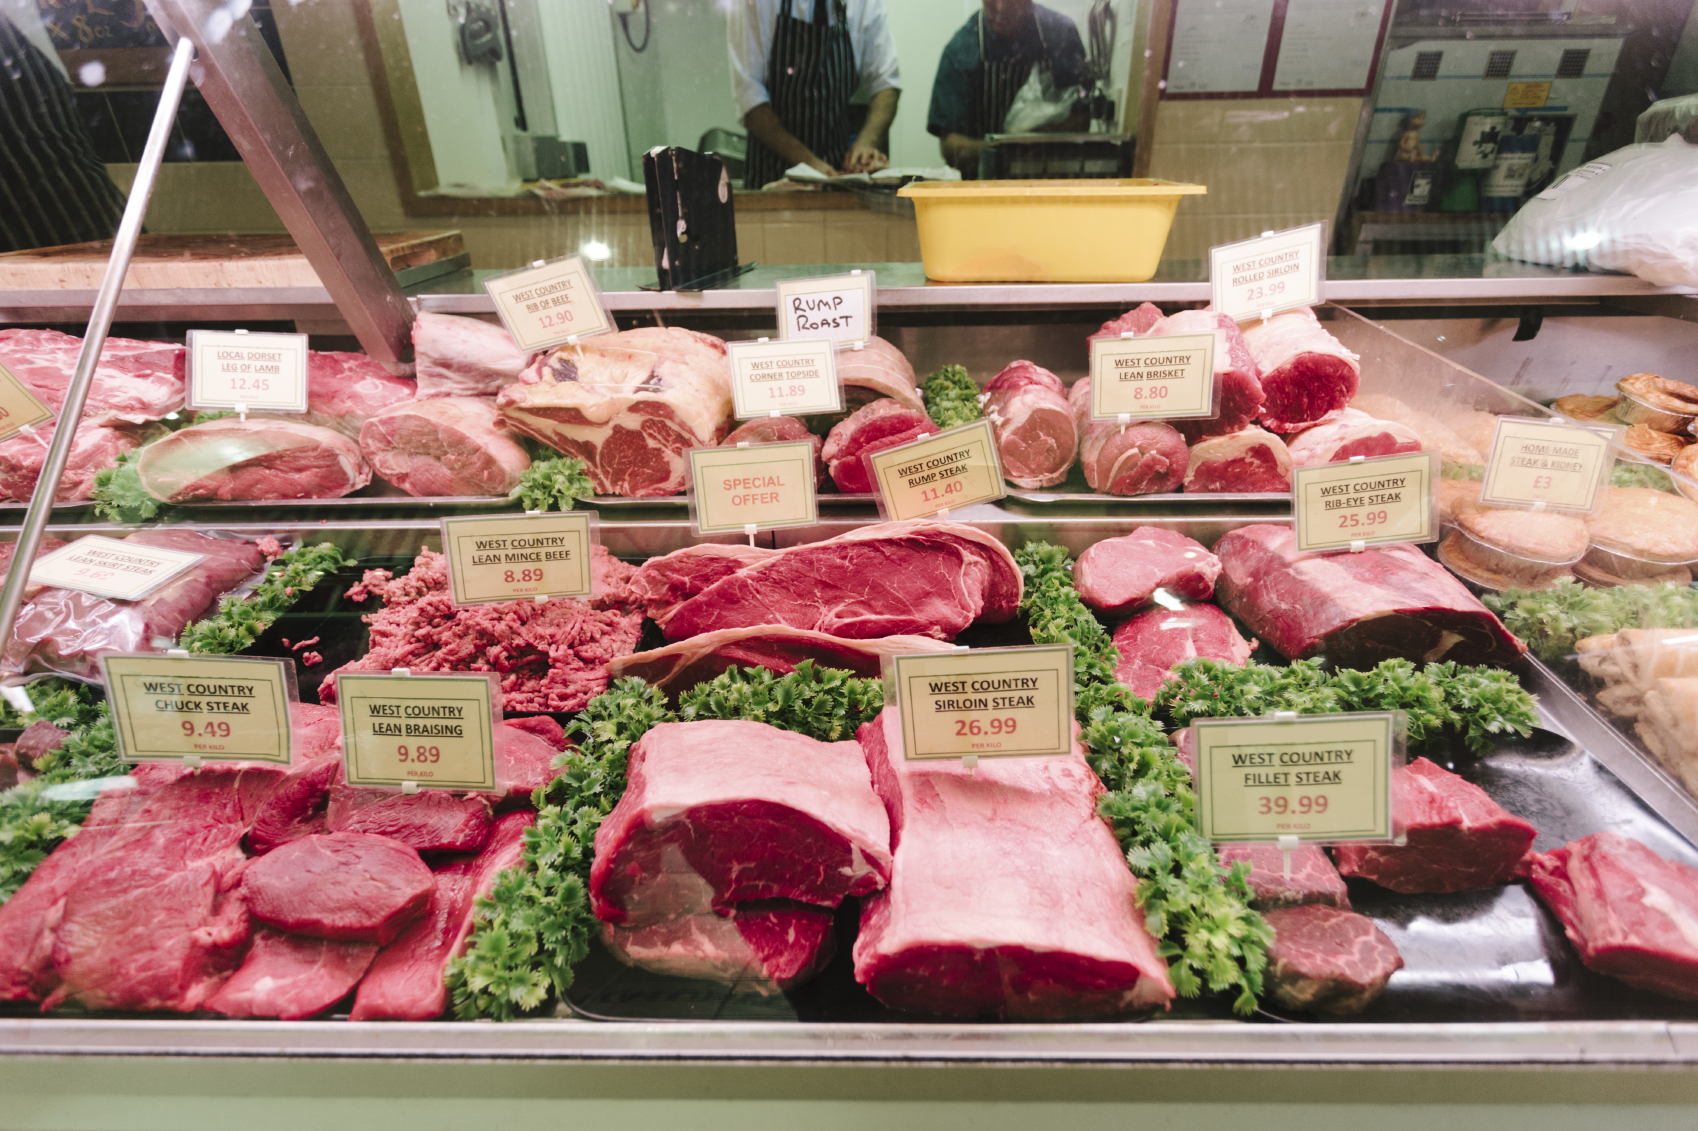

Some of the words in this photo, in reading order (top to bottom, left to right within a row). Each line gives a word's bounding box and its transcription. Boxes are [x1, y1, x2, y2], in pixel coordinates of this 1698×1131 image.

[1232, 260, 1257, 275] WEST
[1258, 249, 1300, 268] COUNTRY
[1232, 271, 1265, 287] ROLLED
[1266, 262, 1300, 279] SIRLOIN
[512, 290, 536, 304] WEST
[534, 279, 573, 298] COUNTRY
[1247, 281, 1285, 301] 23.99
[526, 303, 541, 314] RIB
[539, 299, 552, 310] OF
[551, 294, 572, 307] BEEF
[792, 296, 844, 314] RUMP
[538, 310, 574, 329] 12.90
[796, 314, 853, 332] ROAST
[217, 350, 245, 360] LOCAL
[247, 351, 282, 362] DORSET
[751, 361, 774, 370] WEST
[776, 358, 816, 368] COUNTRY
[1114, 358, 1142, 369] WEST
[1143, 355, 1192, 367] COUNTRY
[221, 363, 238, 372] LEG
[240, 363, 252, 373] OF
[254, 364, 280, 374] LAMB
[749, 372, 784, 382] CORNER
[786, 369, 820, 380] TOPSIDE
[1119, 371, 1144, 382] LEAN
[1146, 369, 1186, 380] BRISKET
[230, 377, 270, 391] 12.45
[768, 384, 806, 398] 11.89
[1133, 385, 1168, 400] 8.80
[1520, 443, 1550, 454] HOME
[1552, 446, 1580, 458] MADE
[897, 463, 925, 478] WEST
[926, 449, 972, 470] COUNTRY
[1510, 456, 1539, 467] STEAK
[1541, 459, 1548, 468] &
[1551, 460, 1583, 473] KIDNEY
[723, 475, 785, 491] SPECIAL
[907, 472, 938, 488] RUMP
[938, 463, 968, 479] STEAK
[1532, 475, 1552, 490] £3
[921, 480, 963, 502] 11.40
[1320, 484, 1351, 497] WEST
[1353, 478, 1406, 493] COUNTRY
[731, 492, 780, 506] OFFER
[1325, 496, 1365, 510] RIB-EYE
[1368, 492, 1401, 505] STEAK
[1338, 510, 1388, 528] 25.99
[476, 539, 508, 551] WEST
[511, 536, 565, 549] COUNTRY
[66, 554, 94, 565] LEAN
[93, 560, 126, 570] SKIRT
[124, 564, 157, 576] STEAK
[84, 549, 116, 561] WEST
[115, 554, 163, 568] COUNTRY
[472, 554, 502, 565] LEAN
[505, 552, 543, 563] MINCE
[545, 550, 571, 561] BEEF
[504, 568, 544, 583] 8.89
[144, 682, 184, 695] WEST
[187, 683, 255, 698] COUNTRY
[929, 681, 968, 695] WEST
[971, 678, 1039, 693] COUNTRY
[155, 699, 204, 713] CHUCK
[207, 701, 251, 714] STEAK
[369, 704, 402, 718] WEST
[404, 705, 464, 719] COUNTRY
[935, 698, 989, 712] SIRLOIN
[992, 695, 1035, 710] STEAK
[181, 720, 231, 737] 9.49
[372, 722, 402, 736] LEAN
[405, 724, 464, 738] BRAISING
[955, 717, 1017, 736] 26.99
[397, 744, 440, 763] 9.89
[1232, 752, 1275, 767] WEST
[1279, 749, 1354, 766] COUNTRY
[1244, 772, 1290, 787] FILLET
[1295, 770, 1342, 785] STEAK
[1258, 795, 1328, 815] 39.99
